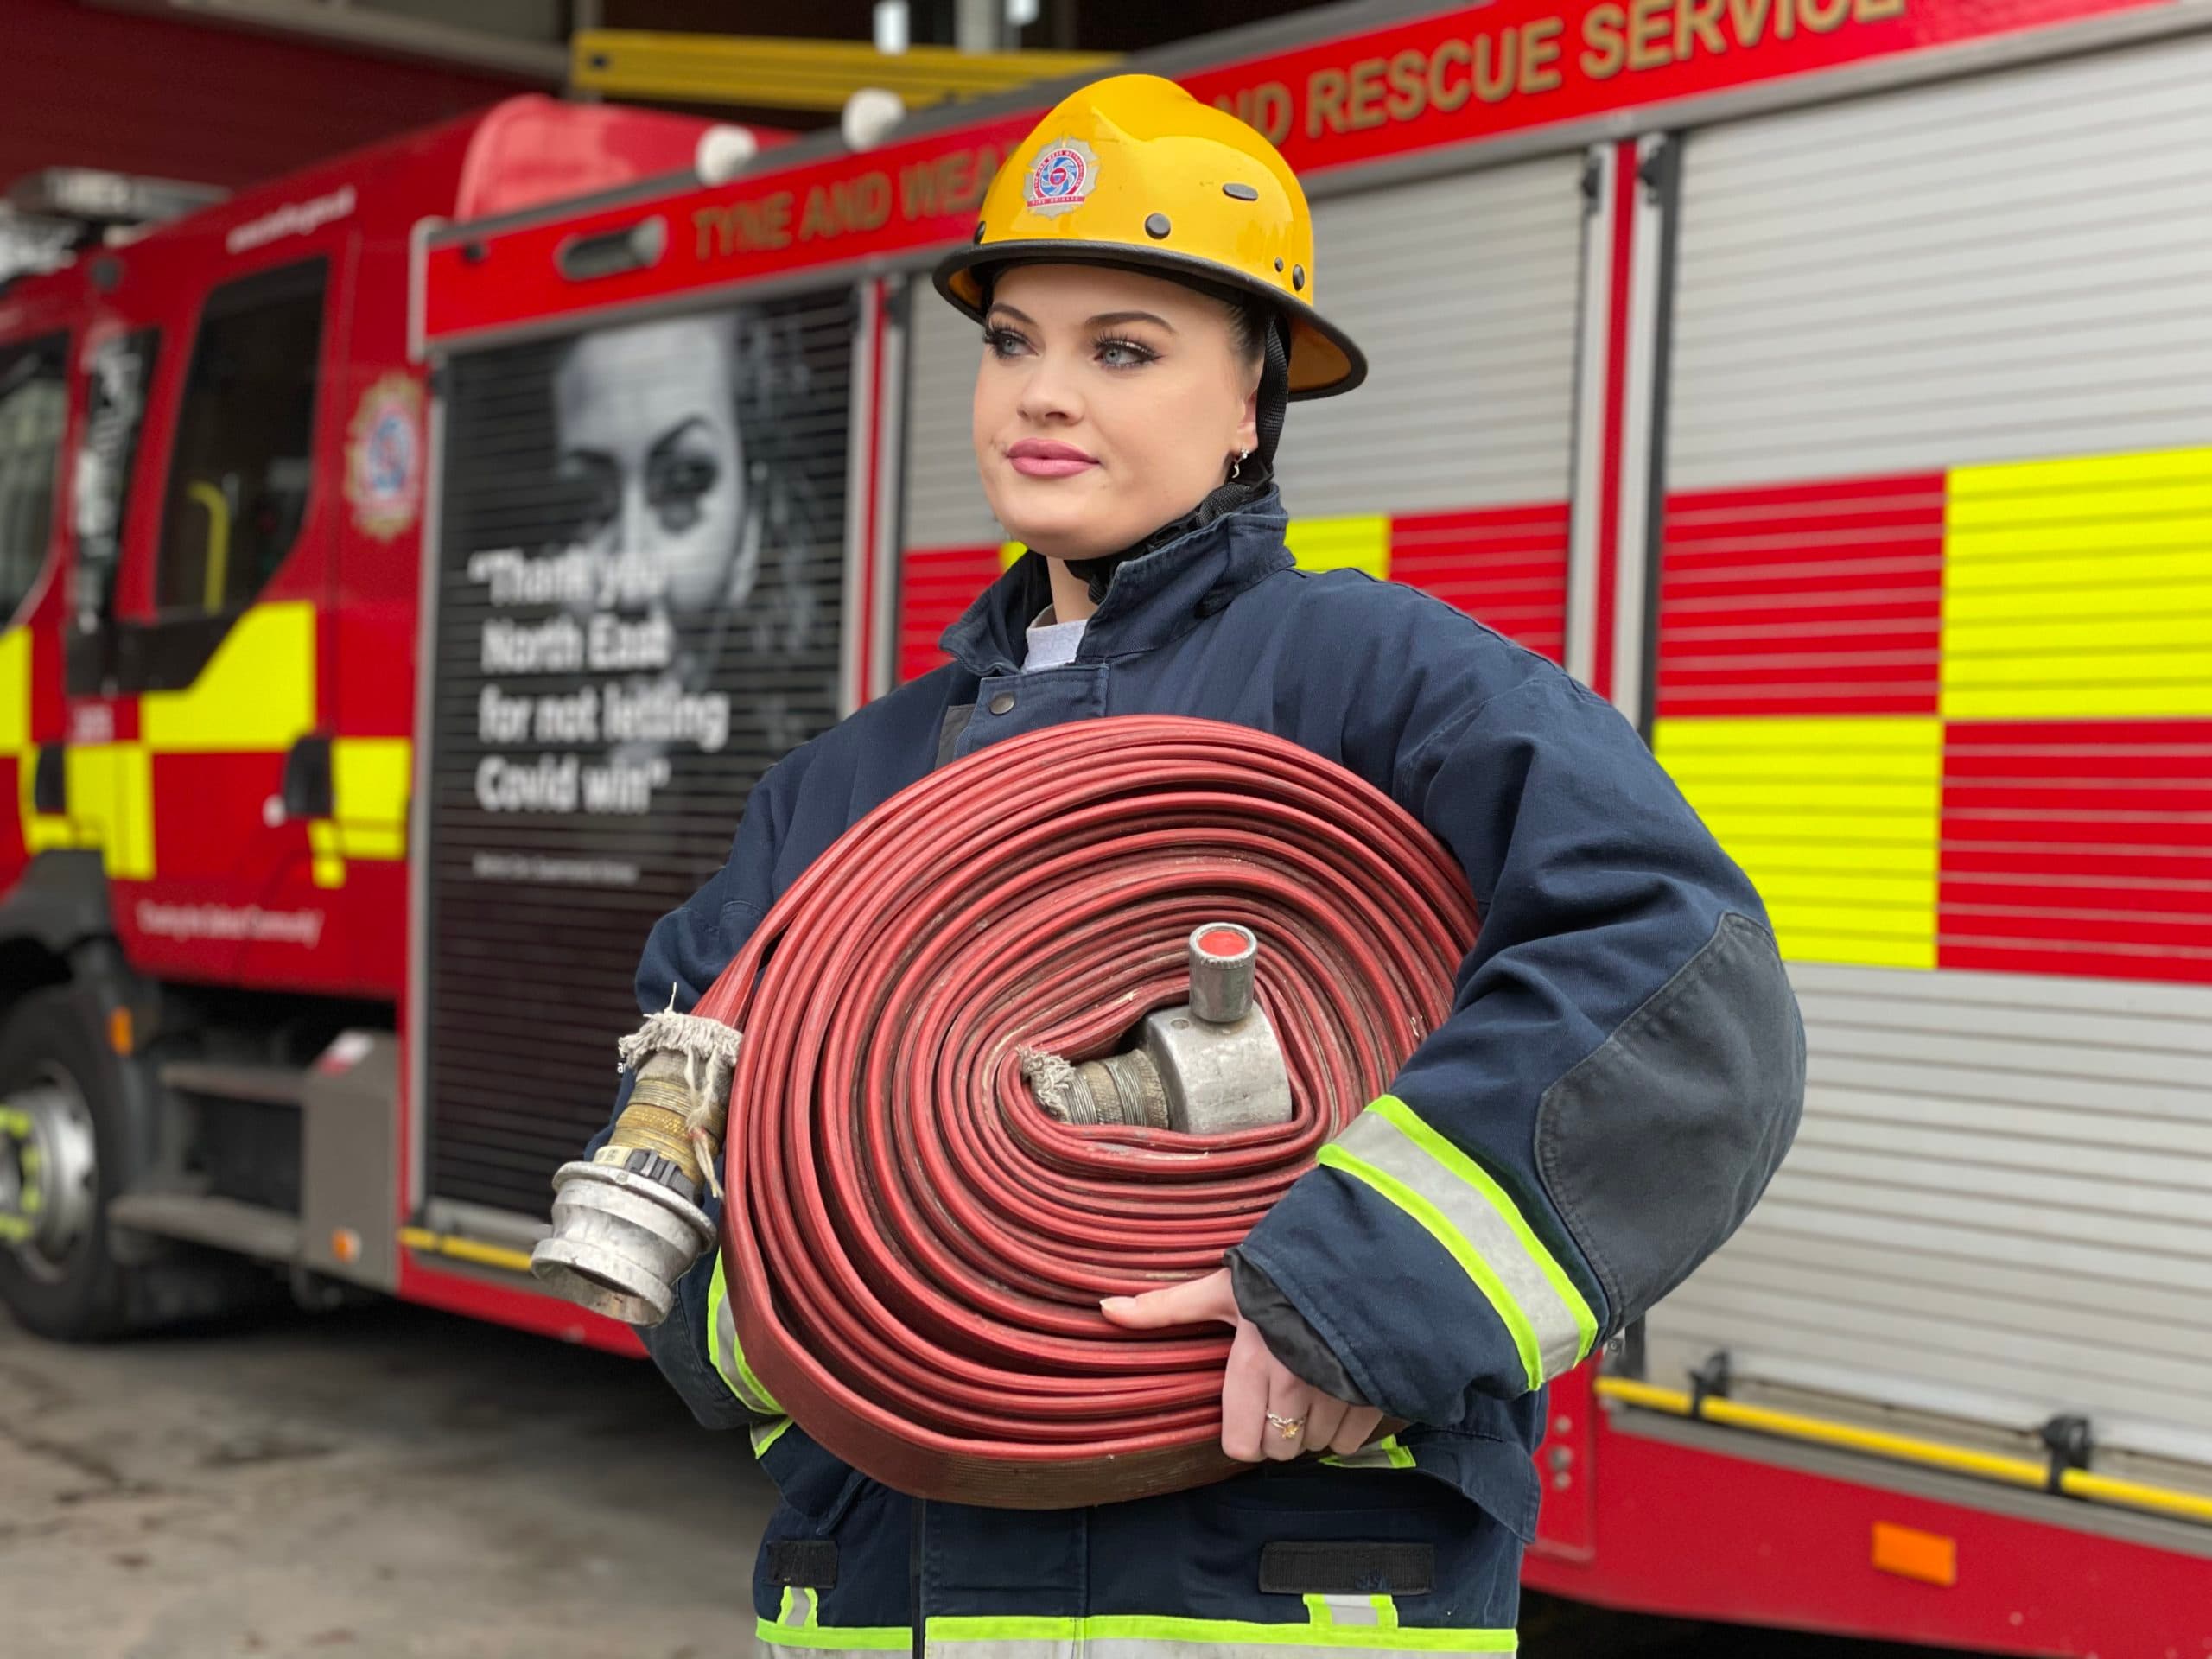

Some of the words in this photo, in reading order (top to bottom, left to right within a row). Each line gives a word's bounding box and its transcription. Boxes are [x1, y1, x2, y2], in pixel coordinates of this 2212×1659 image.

[696, 190, 793, 260] TYNE
[799, 171, 893, 241] AND
[900, 141, 1020, 221] WEA
[1306, 16, 1563, 139] RESCUE
[480, 615, 584, 672] North
[478, 683, 532, 744] for
[534, 687, 600, 744] not
[475, 753, 581, 812] Covid
